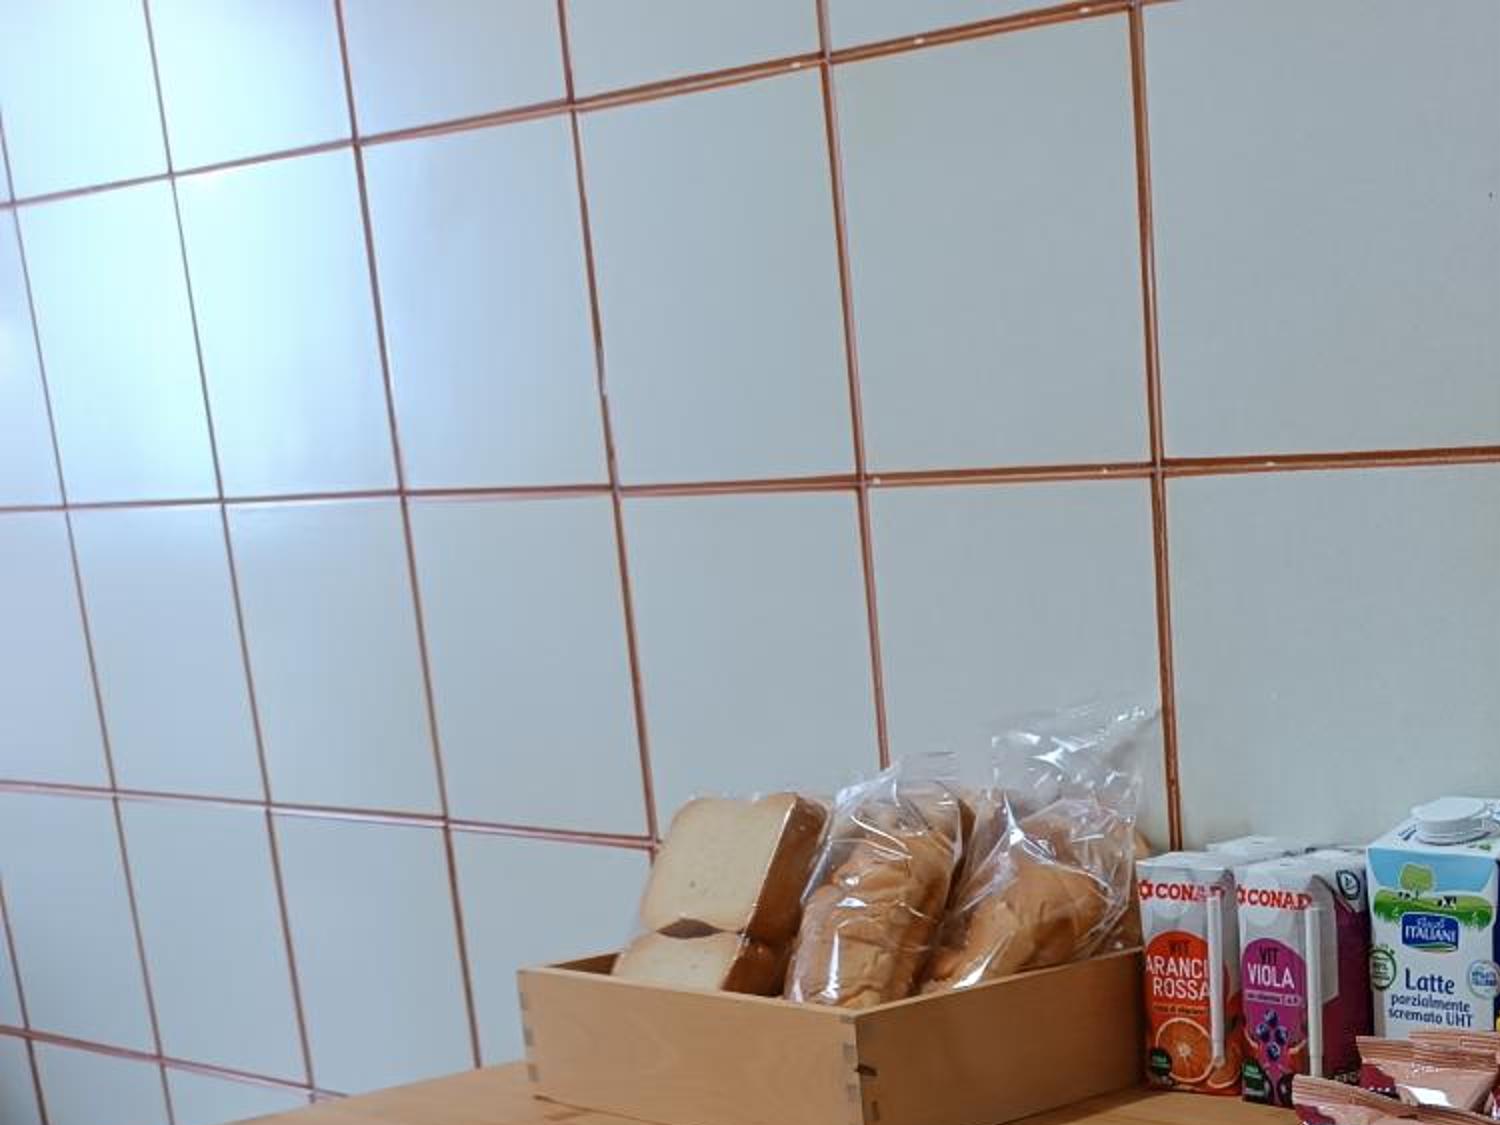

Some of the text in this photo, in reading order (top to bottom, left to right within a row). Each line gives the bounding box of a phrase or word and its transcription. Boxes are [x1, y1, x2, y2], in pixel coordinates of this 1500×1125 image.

[1249, 889, 1313, 911] CONAD
[1405, 925, 1457, 942] ITALIANI
[1145, 955, 1210, 979] ARANCI
[1247, 963, 1295, 990] VIOLA
[1153, 977, 1211, 1001] ROSSA
[1404, 967, 1456, 995] Latte
[1391, 993, 1471, 1013] parzialmente
[1388, 1008, 1473, 1028] scremato UHT
